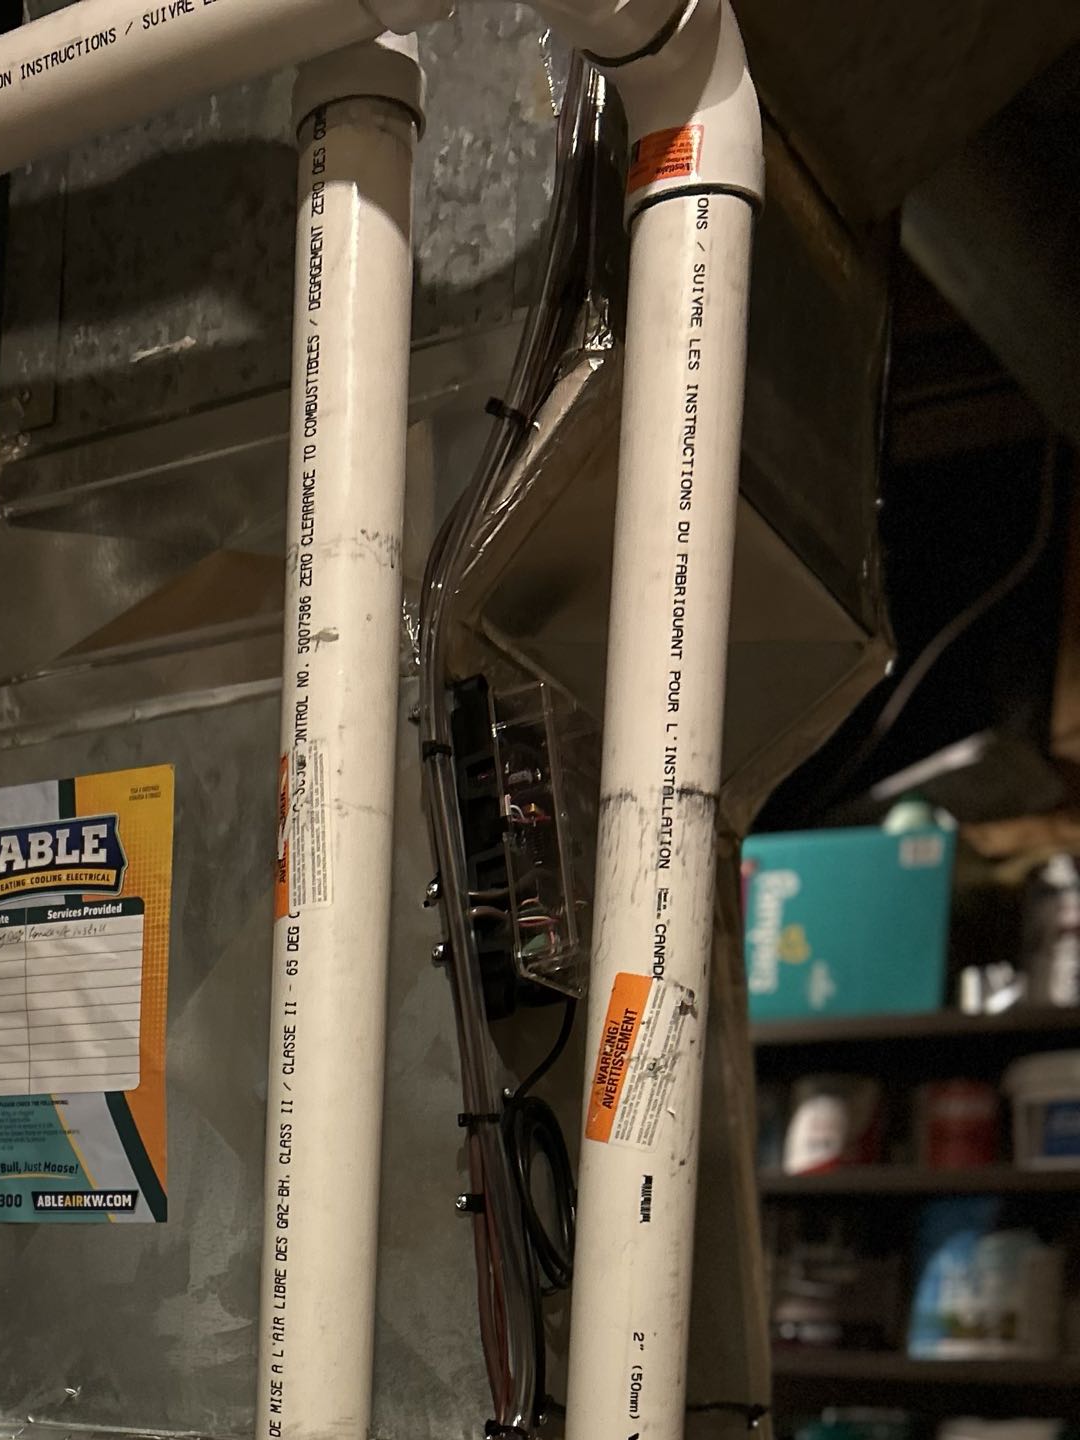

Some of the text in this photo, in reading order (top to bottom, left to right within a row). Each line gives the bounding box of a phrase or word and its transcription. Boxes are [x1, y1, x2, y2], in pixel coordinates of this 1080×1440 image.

[20, 28, 117, 80] INSTRUCTIONS
[142, 0, 195, 29] SUIVRE
[312, 148, 326, 174] DES
[311, 182, 325, 215] ZERO
[696, 197, 710, 230] ONS
[308, 226, 323, 310] DEGAGEMENT
[691, 264, 705, 327] SUIVRE
[688, 339, 701, 371] LES
[304, 335, 320, 437] COMBUSTIBLES
[303, 445, 316, 460] TO
[680, 384, 698, 510] INSTRUCTIONS
[300, 470, 315, 546] CLEARANCE
[678, 521, 690, 544] DU
[299, 553, 312, 587] ZERO
[671, 553, 688, 660] FABRIQUANT
[298, 596, 311, 654] 5007586
[296, 663, 309, 687] NO.
[667, 671, 681, 712] POUR
[295, 696, 309, 742] ONTROL
[658, 723, 678, 869] L'INSTALLATION
[30, 874, 62, 885] COOLING
[66, 873, 110, 882] ELECTRICAL
[47, 903, 122, 919] Services Provided
[286, 927, 300, 951] DEG
[286, 960, 298, 976] 65
[284, 1002, 296, 1015] II
[282, 1025, 295, 1075] CLASSE
[602, 1008, 638, 1109] AVERTISSEMENT
[281, 1100, 293, 1113] II
[279, 1124, 292, 1164] CLASS
[0, 1161, 21, 1174] Bull,
[23, 1161, 42, 1172] Just
[43, 1162, 79, 1174] Moose!
[37, 1195, 132, 1207] ABLEAIRKW.COM
[276, 1175, 290, 1229] GAZ-BH.
[276, 1237, 288, 1261] DES
[274, 1269, 287, 1310] LIBRE
[271, 1317, 285, 1357] L'AIR
[633, 1332, 644, 1351] 2"
[271, 1364, 283, 1373] A
[270, 1380, 283, 1413] MISE
[629, 1365, 643, 1419] (50mm)
[269, 1420, 281, 1437] DE
